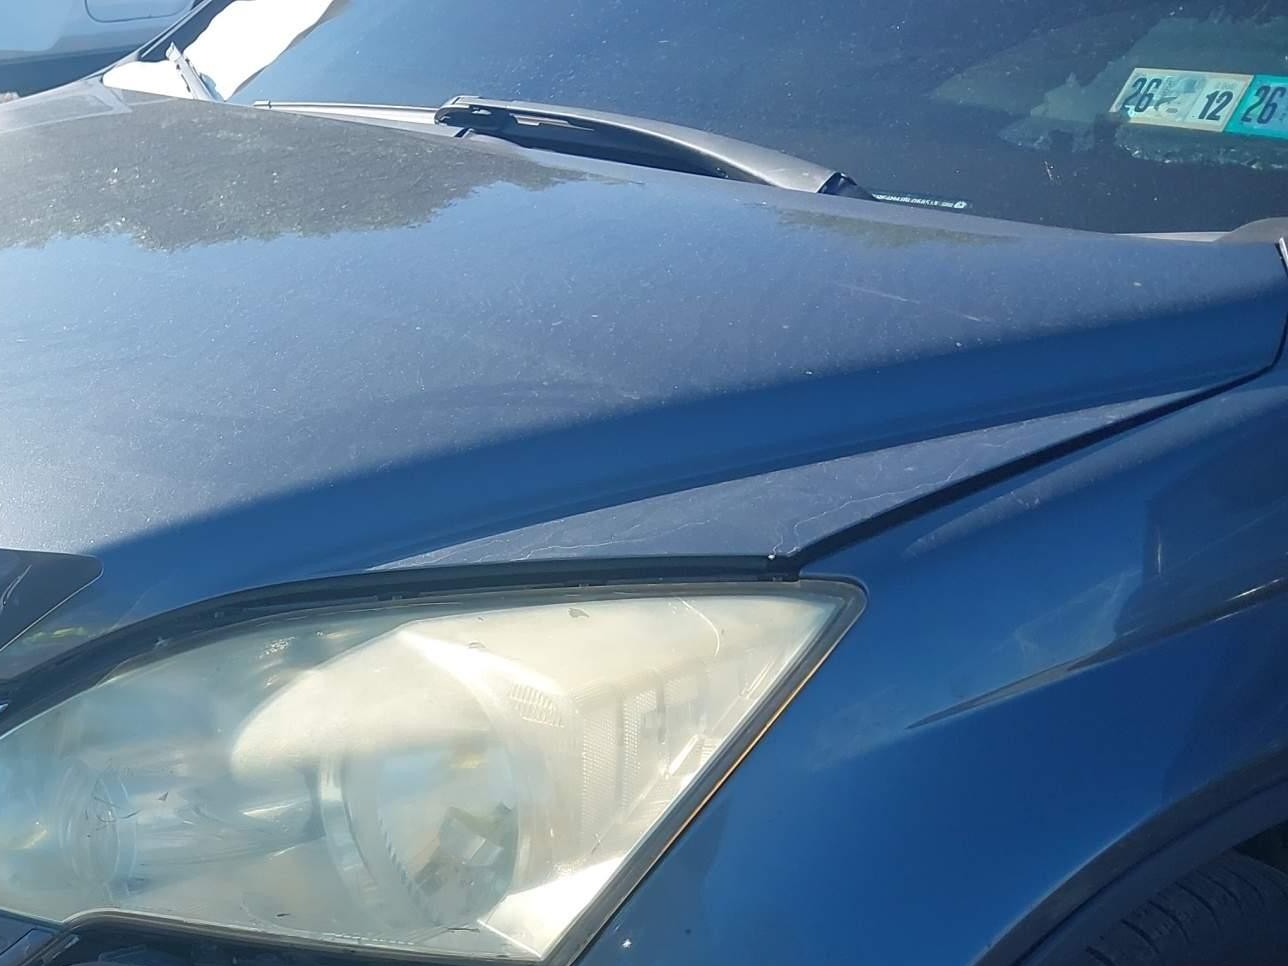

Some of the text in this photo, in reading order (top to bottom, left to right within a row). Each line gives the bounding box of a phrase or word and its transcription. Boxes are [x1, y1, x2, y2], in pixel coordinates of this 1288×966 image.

[1121, 77, 1234, 121] 26 12
[1240, 85, 1287, 125] 26
